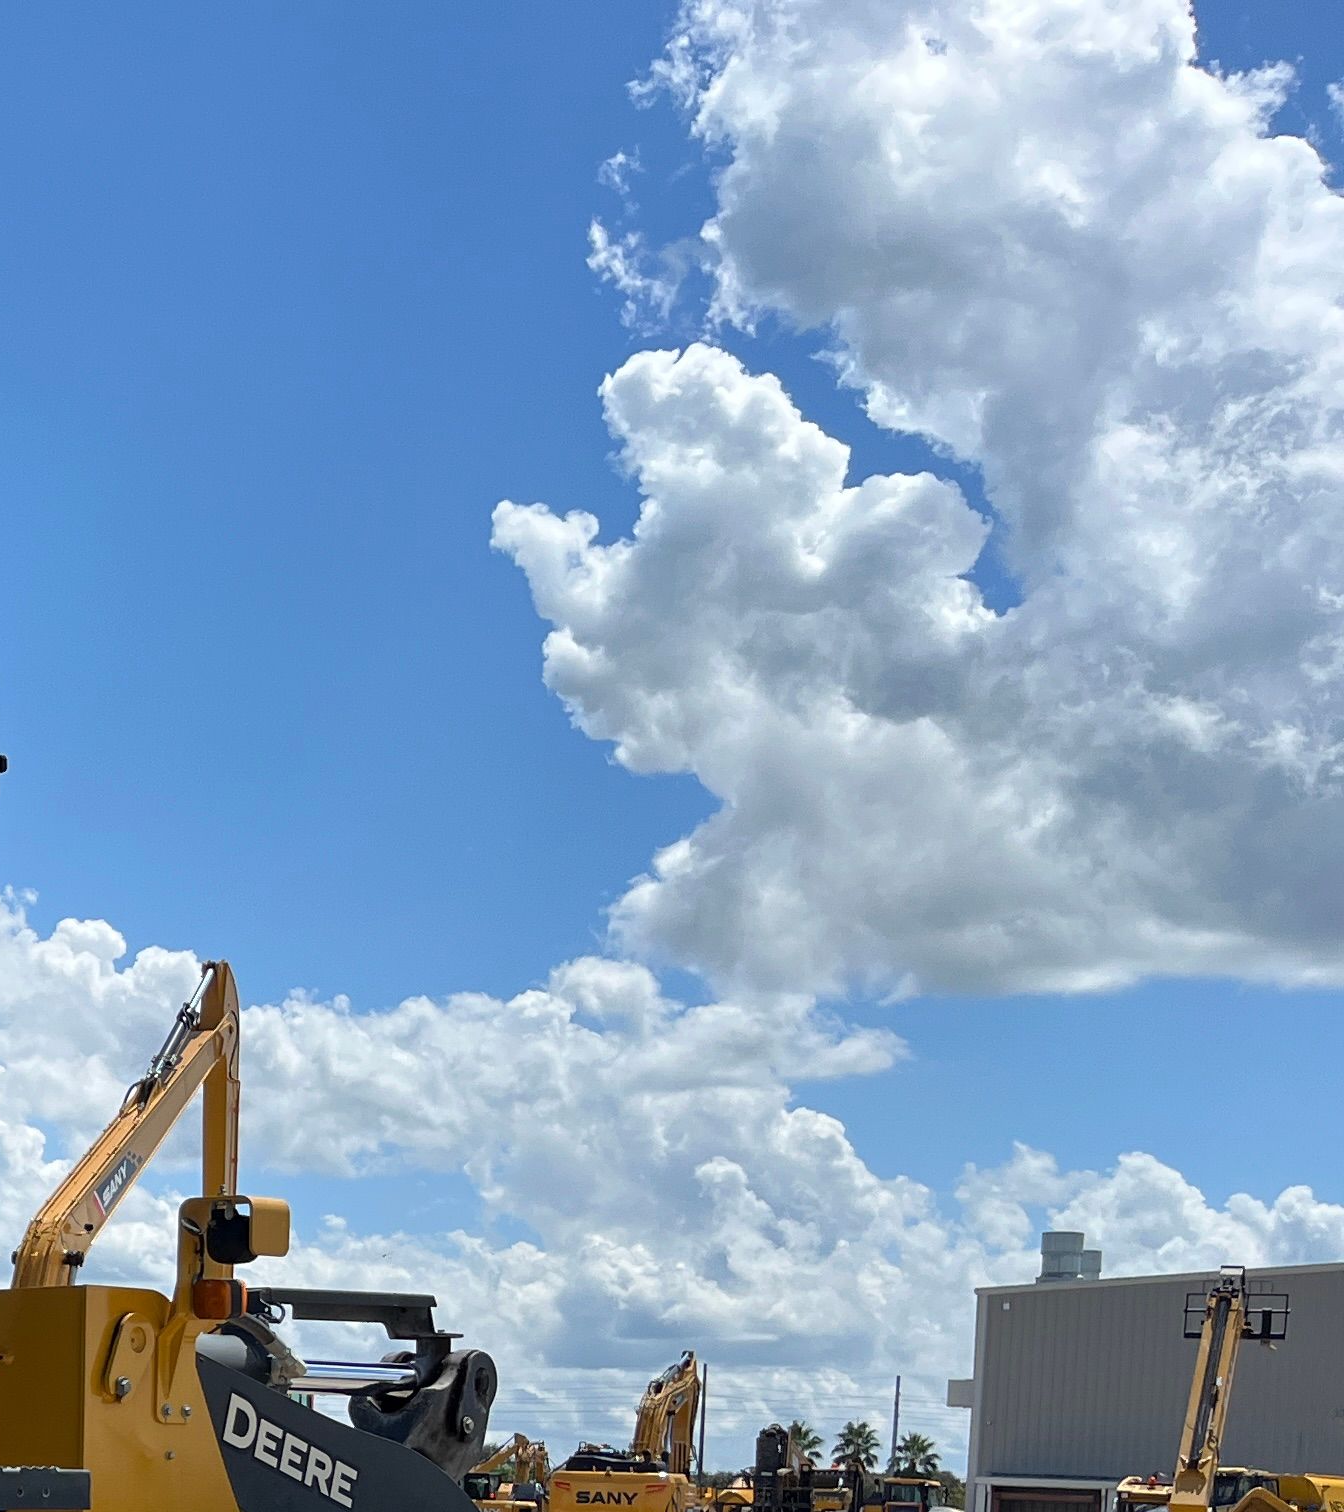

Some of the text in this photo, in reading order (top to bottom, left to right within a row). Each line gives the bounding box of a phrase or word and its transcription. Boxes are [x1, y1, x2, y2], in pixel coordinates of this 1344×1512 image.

[102, 1159, 127, 1208] SANY
[222, 1392, 359, 1509] DEERE
[575, 1490, 639, 1506] SANY
